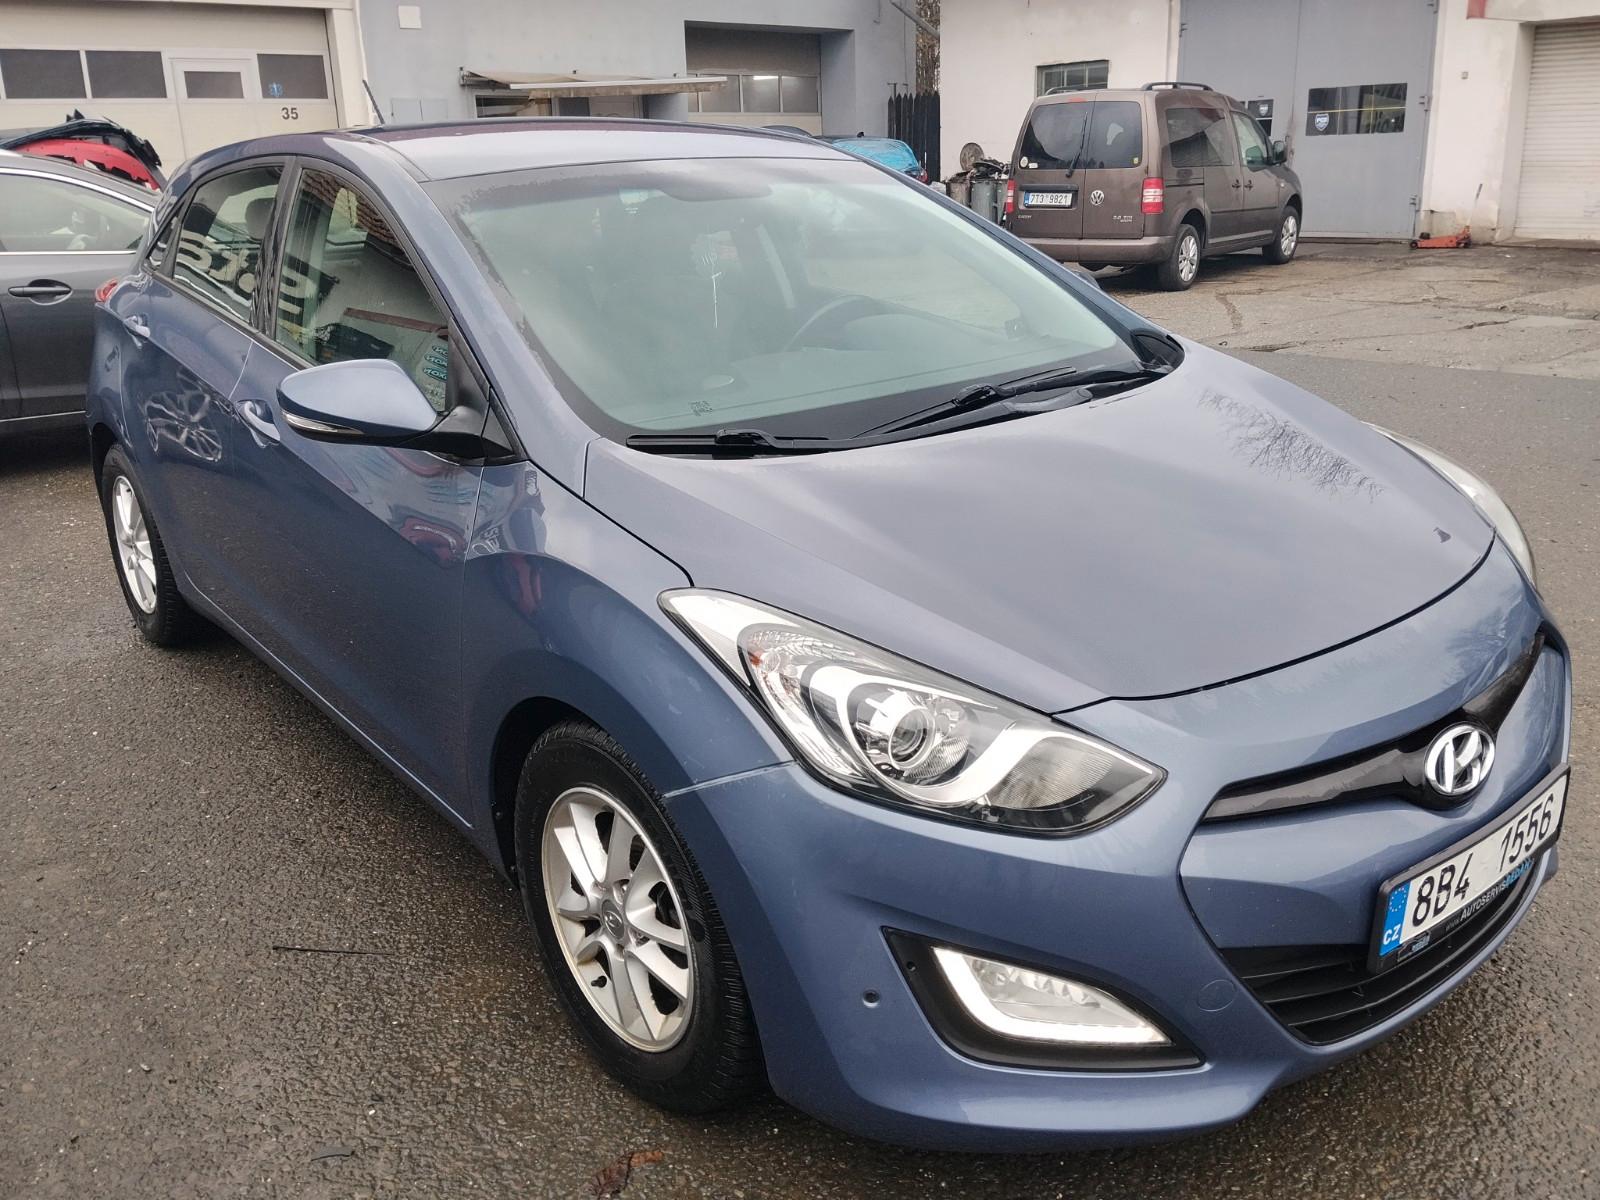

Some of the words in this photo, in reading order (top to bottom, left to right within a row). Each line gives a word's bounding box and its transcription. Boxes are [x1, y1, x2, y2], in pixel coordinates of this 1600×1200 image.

[281, 106, 299, 121] 35
[1412, 852, 1474, 928] 8B4
[1499, 792, 1554, 874] 1556
[1383, 923, 1401, 945] CZ
